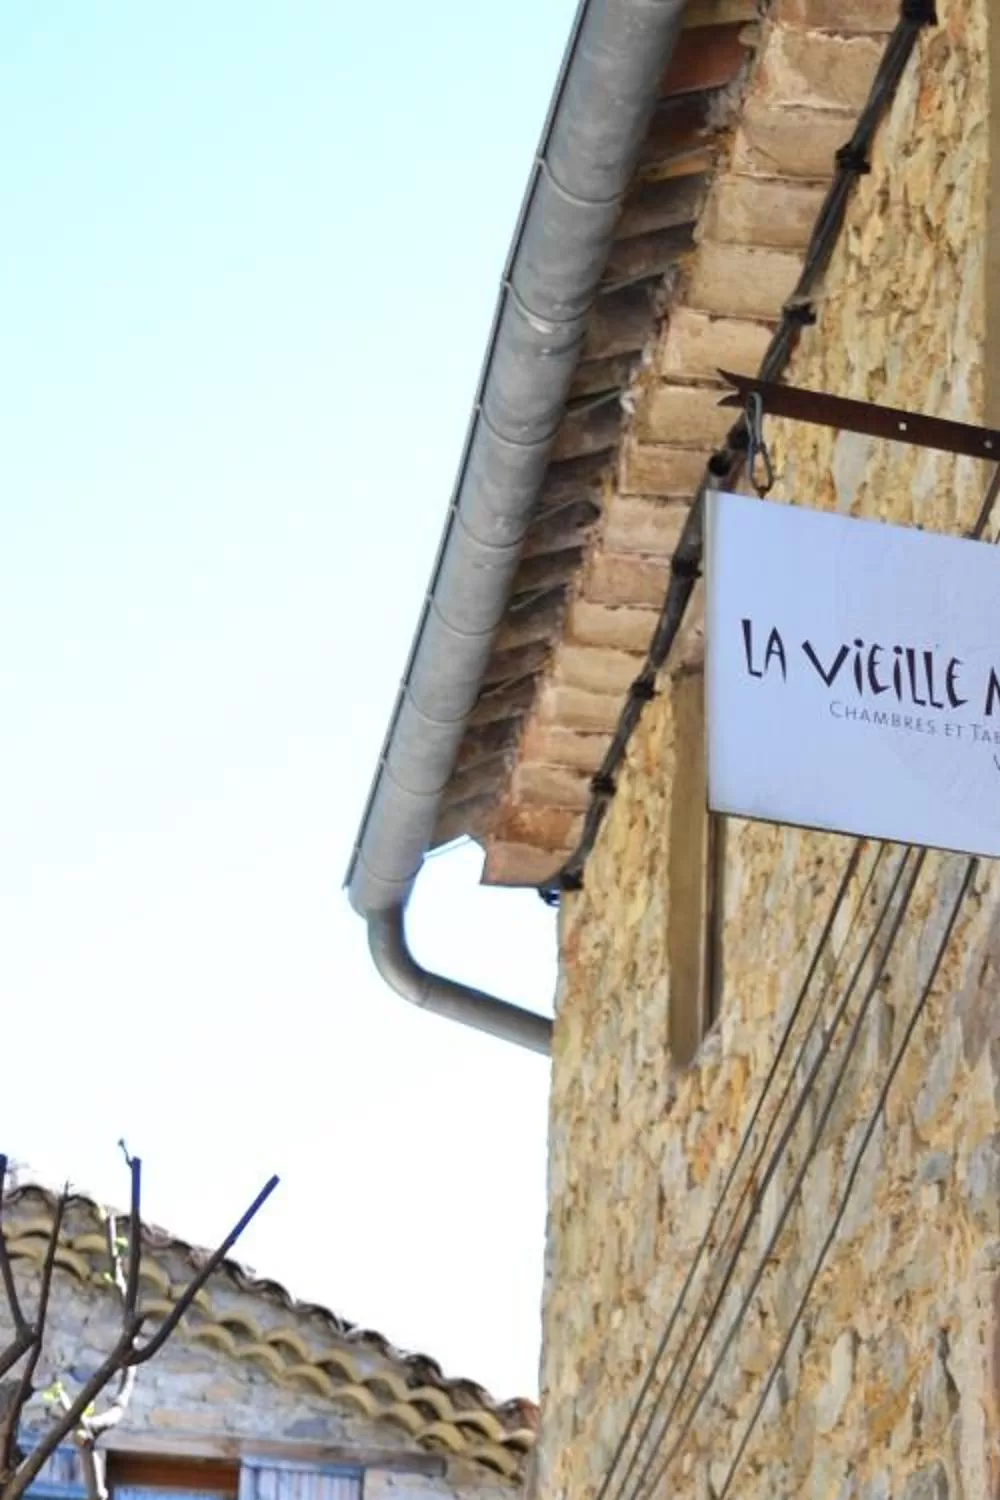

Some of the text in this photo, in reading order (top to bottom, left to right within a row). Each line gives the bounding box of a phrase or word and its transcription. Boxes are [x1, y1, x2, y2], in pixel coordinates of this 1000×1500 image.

[741, 618, 788, 683] LA
[829, 701, 936, 735] CHAMBRES
[943, 722, 965, 738] ET
